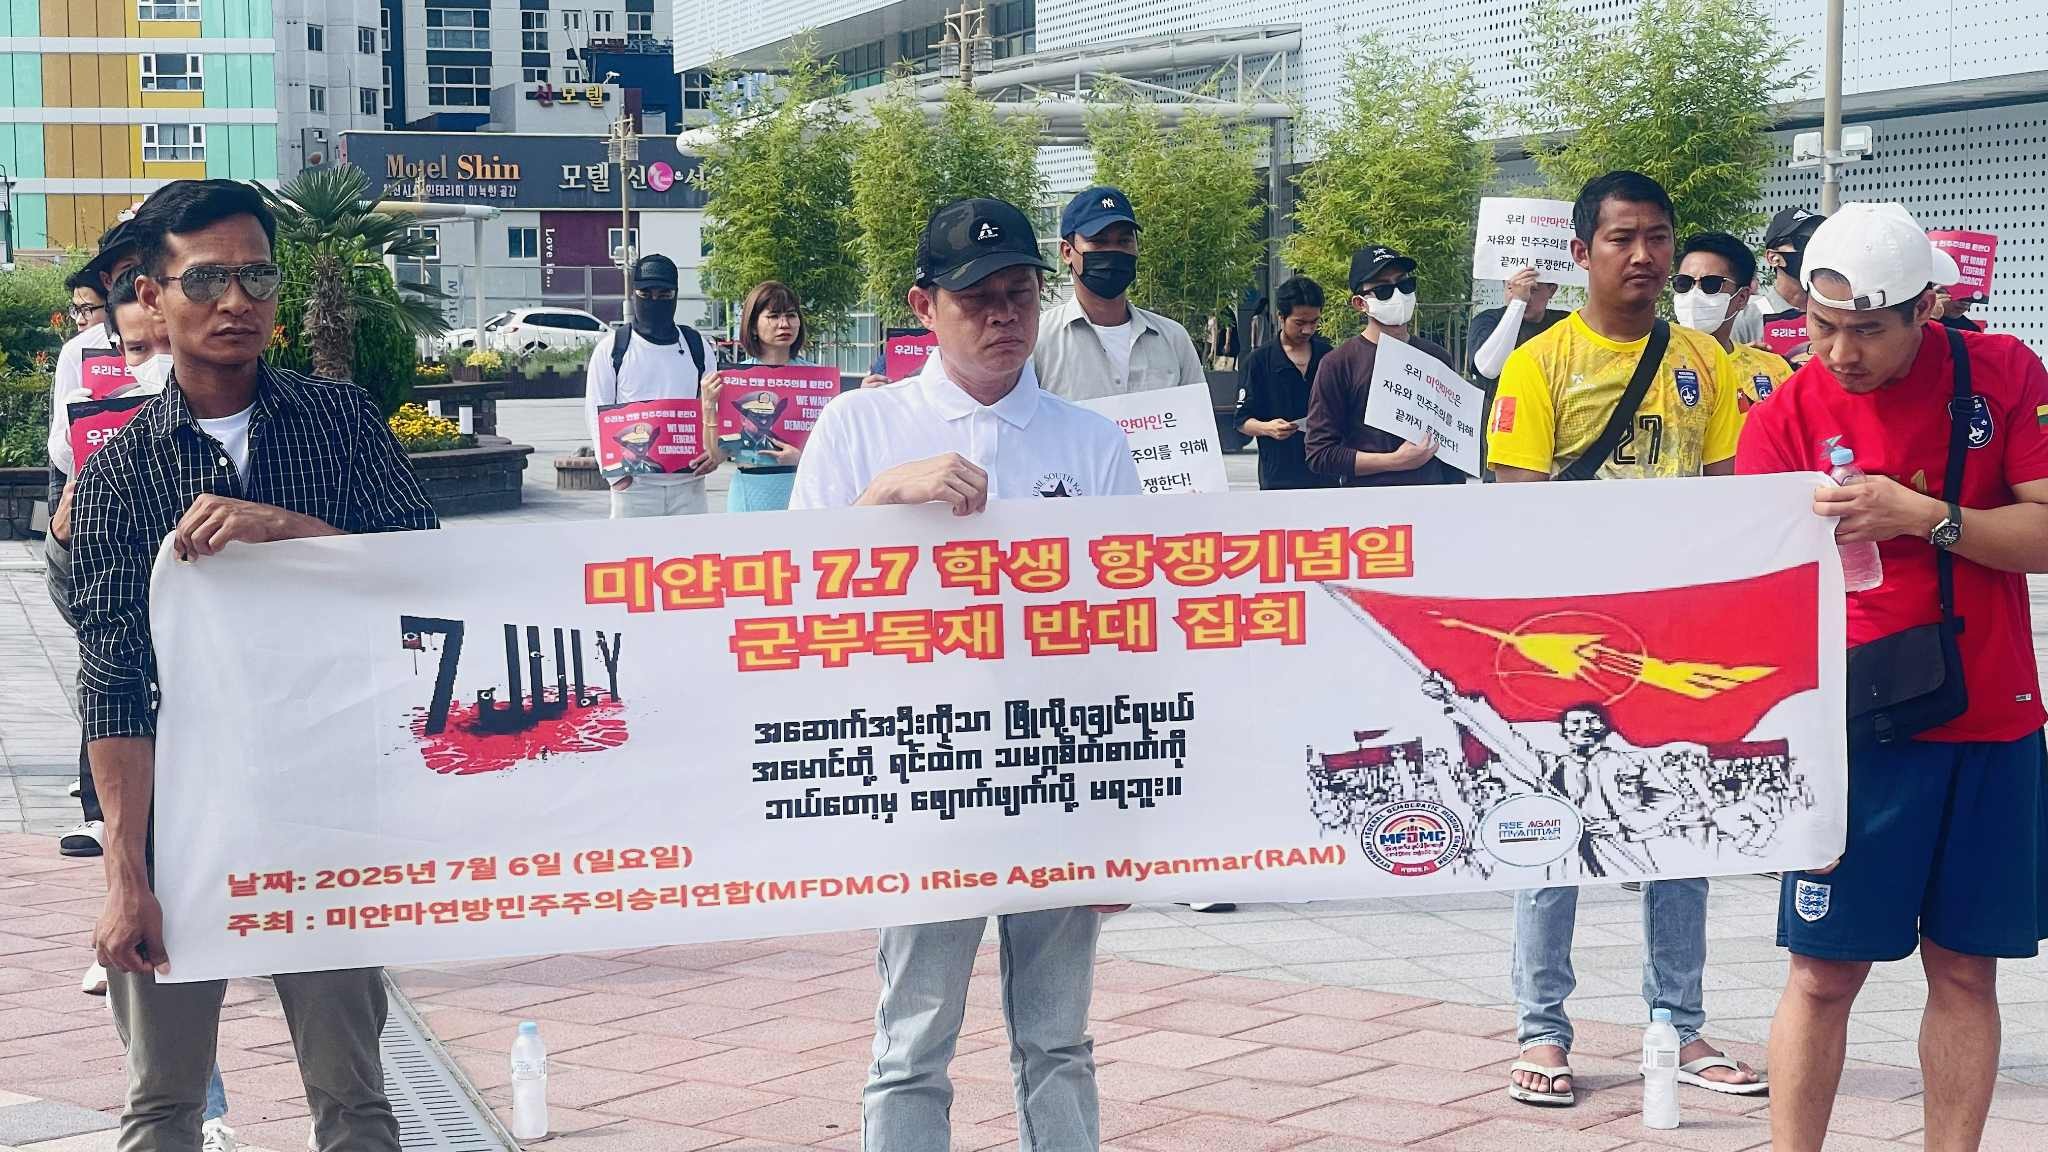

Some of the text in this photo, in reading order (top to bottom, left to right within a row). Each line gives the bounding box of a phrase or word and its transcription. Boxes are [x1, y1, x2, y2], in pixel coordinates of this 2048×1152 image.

[559, 85, 605, 108] 모텔
[457, 153, 521, 180] Shin
[558, 162, 649, 192] 모텔 신
[1505, 214, 1525, 225] 우리
[545, 228, 556, 258] Love
[1487, 234, 1568, 251] 자유와 민주주의를
[1500, 256, 1575, 272] 끝까지 투쟁한다!
[1770, 328, 1797, 338] 우리는
[894, 344, 924, 356] 우리는
[90, 365, 122, 377] 우리는
[723, 376, 748, 386] 우리는
[1404, 363, 1422, 381] 우리
[796, 395, 809, 406] WE
[1383, 379, 1474, 438] 자유와 민주주의를 위해
[666, 423, 696, 433] WE WANT
[1115, 412, 1177, 434] 얀마인은
[1395, 408, 1422, 430] 끝까지
[1130, 438, 1208, 464] 주의를 위해
[1143, 472, 1192, 494] 쟁한다!
[585, 525, 1413, 613] 미얀마 7.7 학생 항쟁기념일
[729, 591, 1306, 672] 군부독재 반대 집회
[1379, 830, 1447, 844] MFDMC
[227, 844, 694, 897] 날짜: 2025년 7월 6일 (일요일)
[227, 910, 294, 936] 주최
[1007, 862, 1096, 889] Again
[1105, 844, 1347, 882] Myanmar(RAM)
